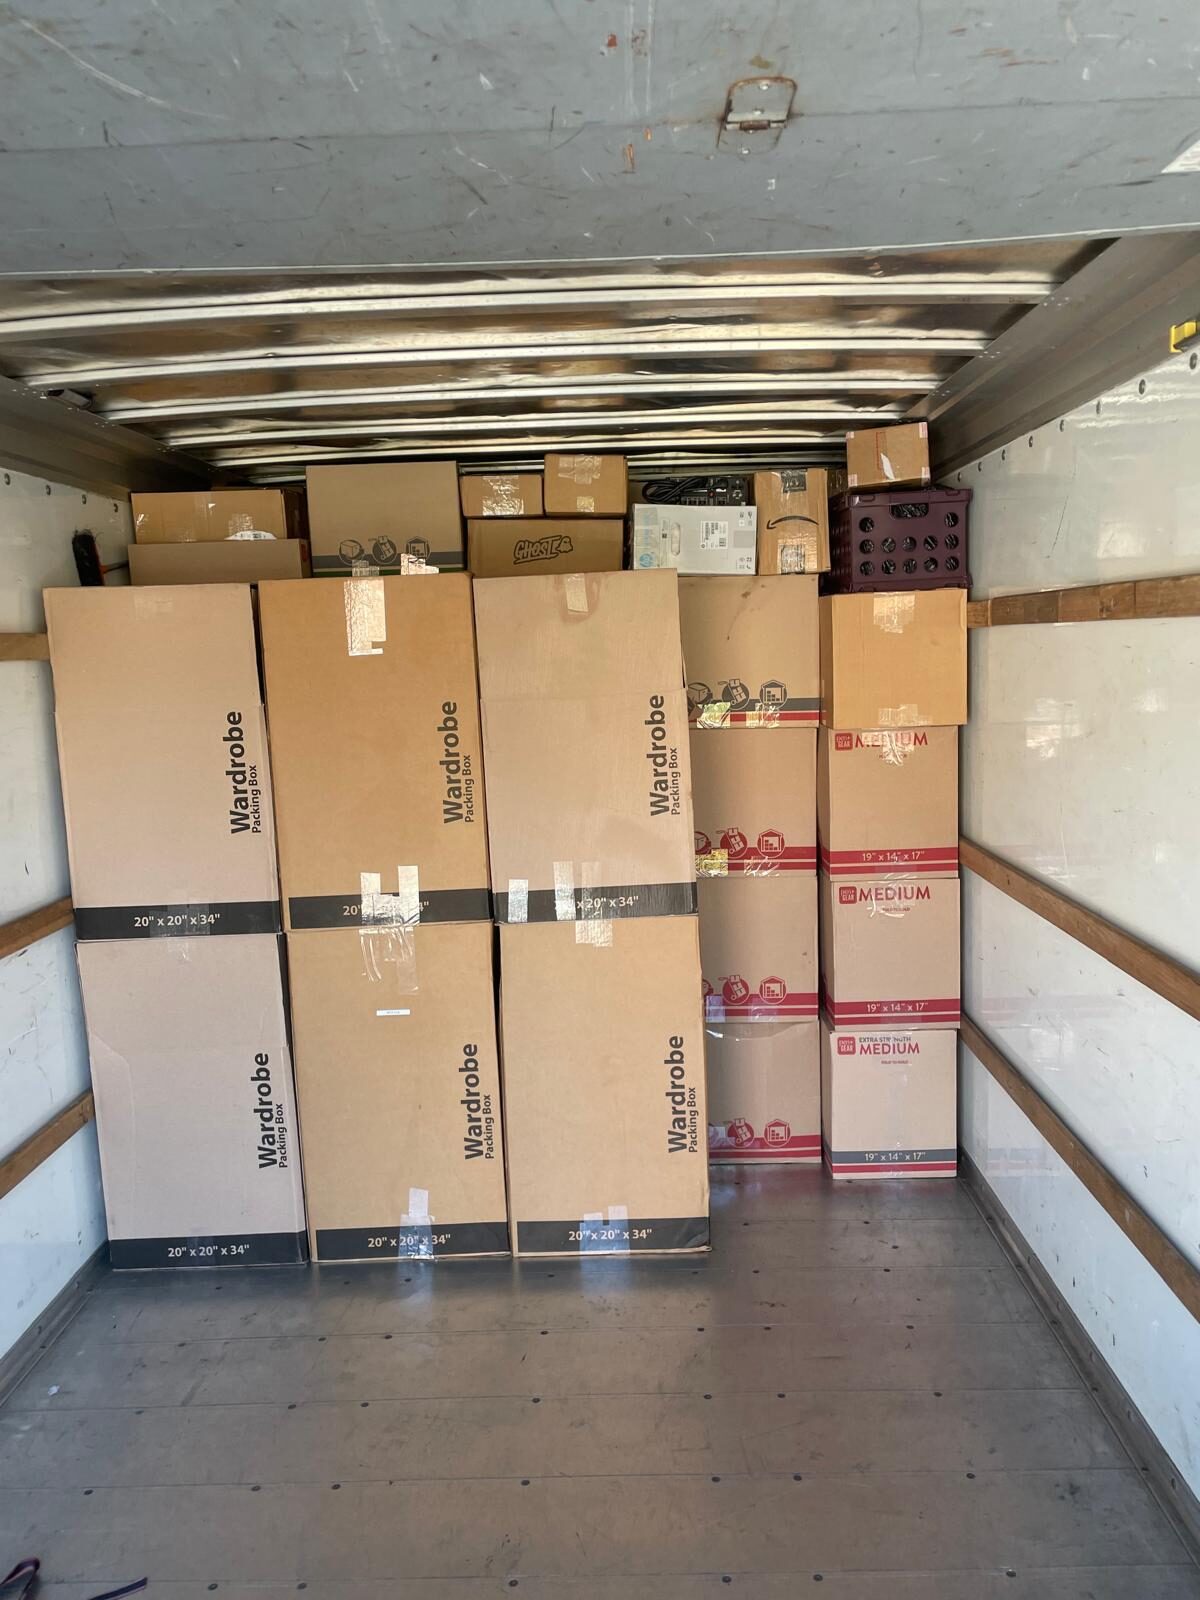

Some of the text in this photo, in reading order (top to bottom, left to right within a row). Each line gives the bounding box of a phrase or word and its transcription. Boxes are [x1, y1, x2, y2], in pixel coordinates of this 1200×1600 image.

[222, 711, 251, 834] Wardrobe
[437, 700, 464, 824] Wardrobe
[644, 694, 670, 817] Wardrobe
[669, 747, 681, 816] Packing Box
[248, 764, 262, 834] Packing Box
[462, 754, 475, 823] Packing Box
[862, 852, 877, 861] 19"
[887, 851, 901, 861] 14"
[912, 850, 925, 860] 17"
[134, 913, 220, 927] 20" x 20" x 34"
[586, 897, 606, 908] 20"
[609, 898, 617, 907] x
[618, 895, 639, 907] 34"
[859, 886, 931, 902] MEDIUM
[866, 1003, 881, 1012] 19"
[891, 1003, 905, 1012] 14"
[915, 1002, 928, 1011] 17"
[860, 1043, 920, 1055] MEDIUM
[250, 1052, 278, 1169] Wardrobe
[458, 1043, 484, 1160] Wardrobe
[482, 1094, 495, 1159] Packing Box
[664, 1035, 688, 1154] Wardrobe
[687, 1087, 699, 1153] Packing Box
[275, 1103, 288, 1168] Packing Box
[865, 1152, 879, 1161] 19"
[888, 1152, 903, 1161] 14"
[913, 1152, 926, 1160] 17"
[167, 1244, 250, 1257] 20" x 20" x 34"
[367, 1233, 451, 1248] 20" x 20" x 34"
[567, 1228, 652, 1241] 20" x 20" x 34"
